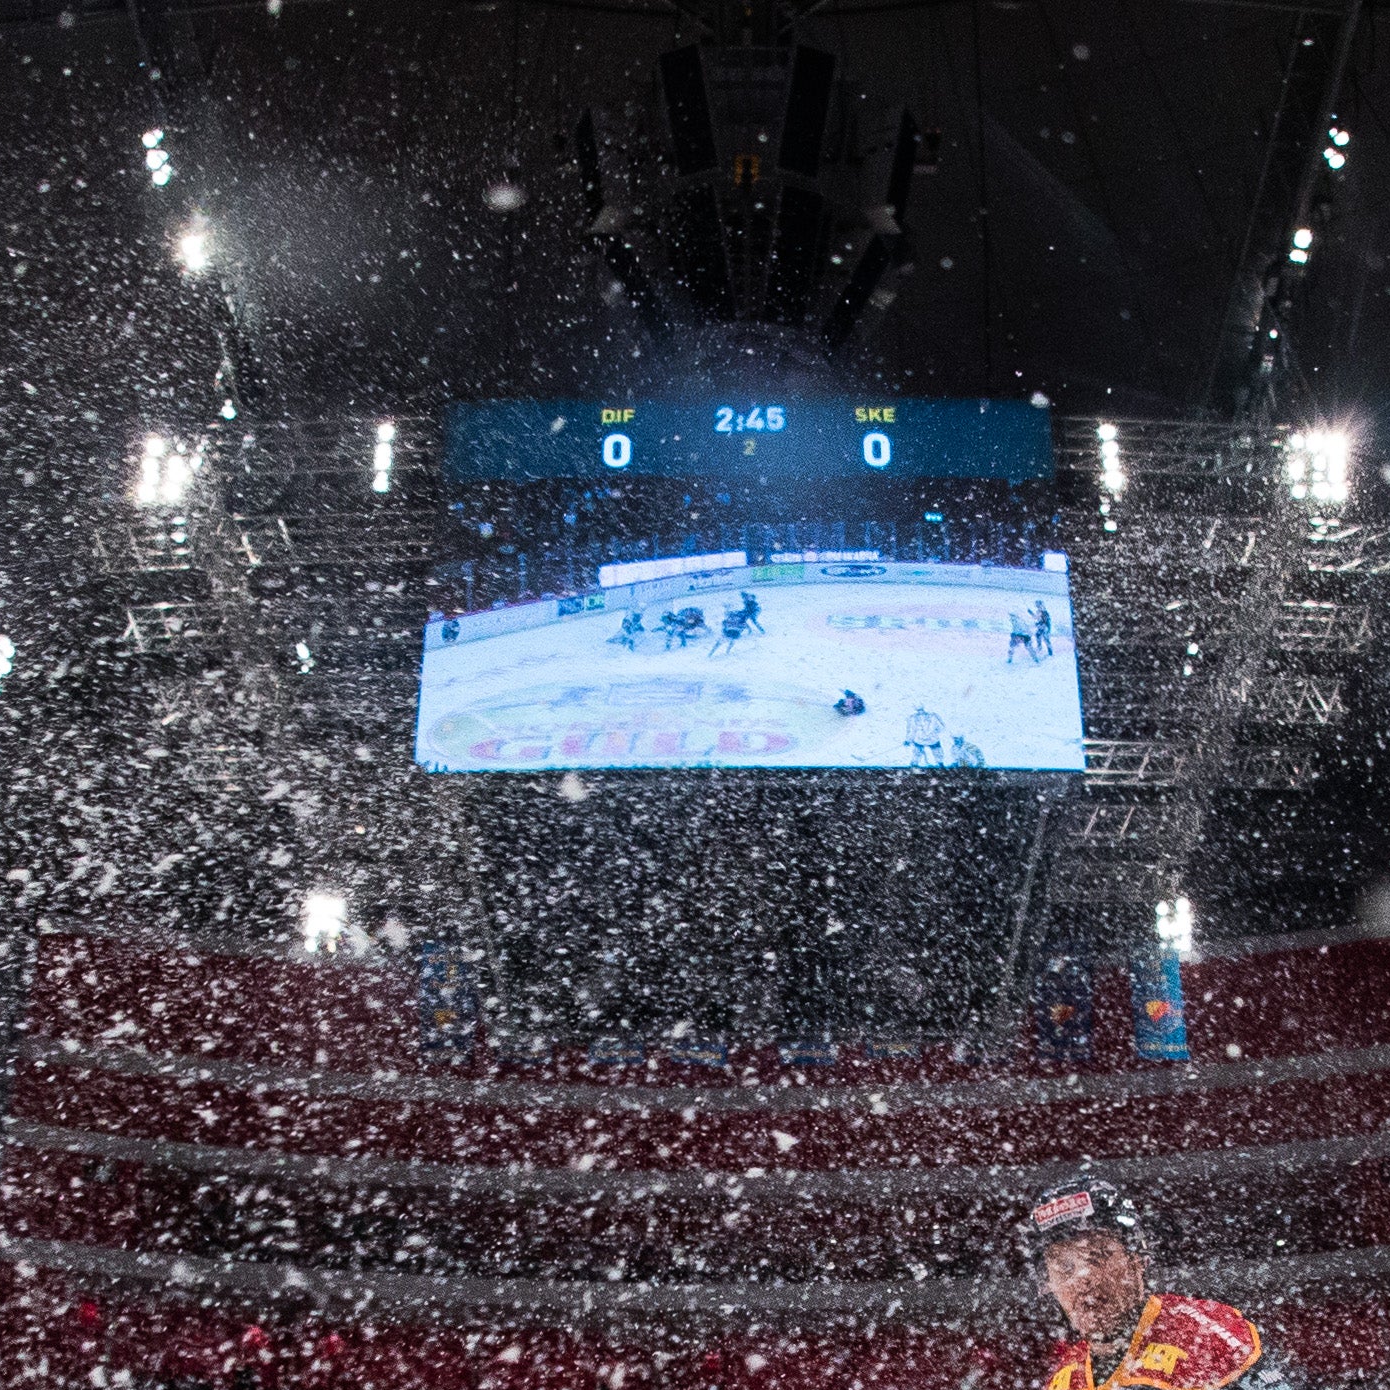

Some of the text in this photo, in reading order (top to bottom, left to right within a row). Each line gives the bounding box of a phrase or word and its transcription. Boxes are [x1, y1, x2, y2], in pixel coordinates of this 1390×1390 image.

[600, 408, 636, 424] DIF
[715, 405, 786, 433] 2:45
[854, 406, 896, 424] SKE
[602, 433, 632, 468] 0
[862, 432, 892, 468] 0
